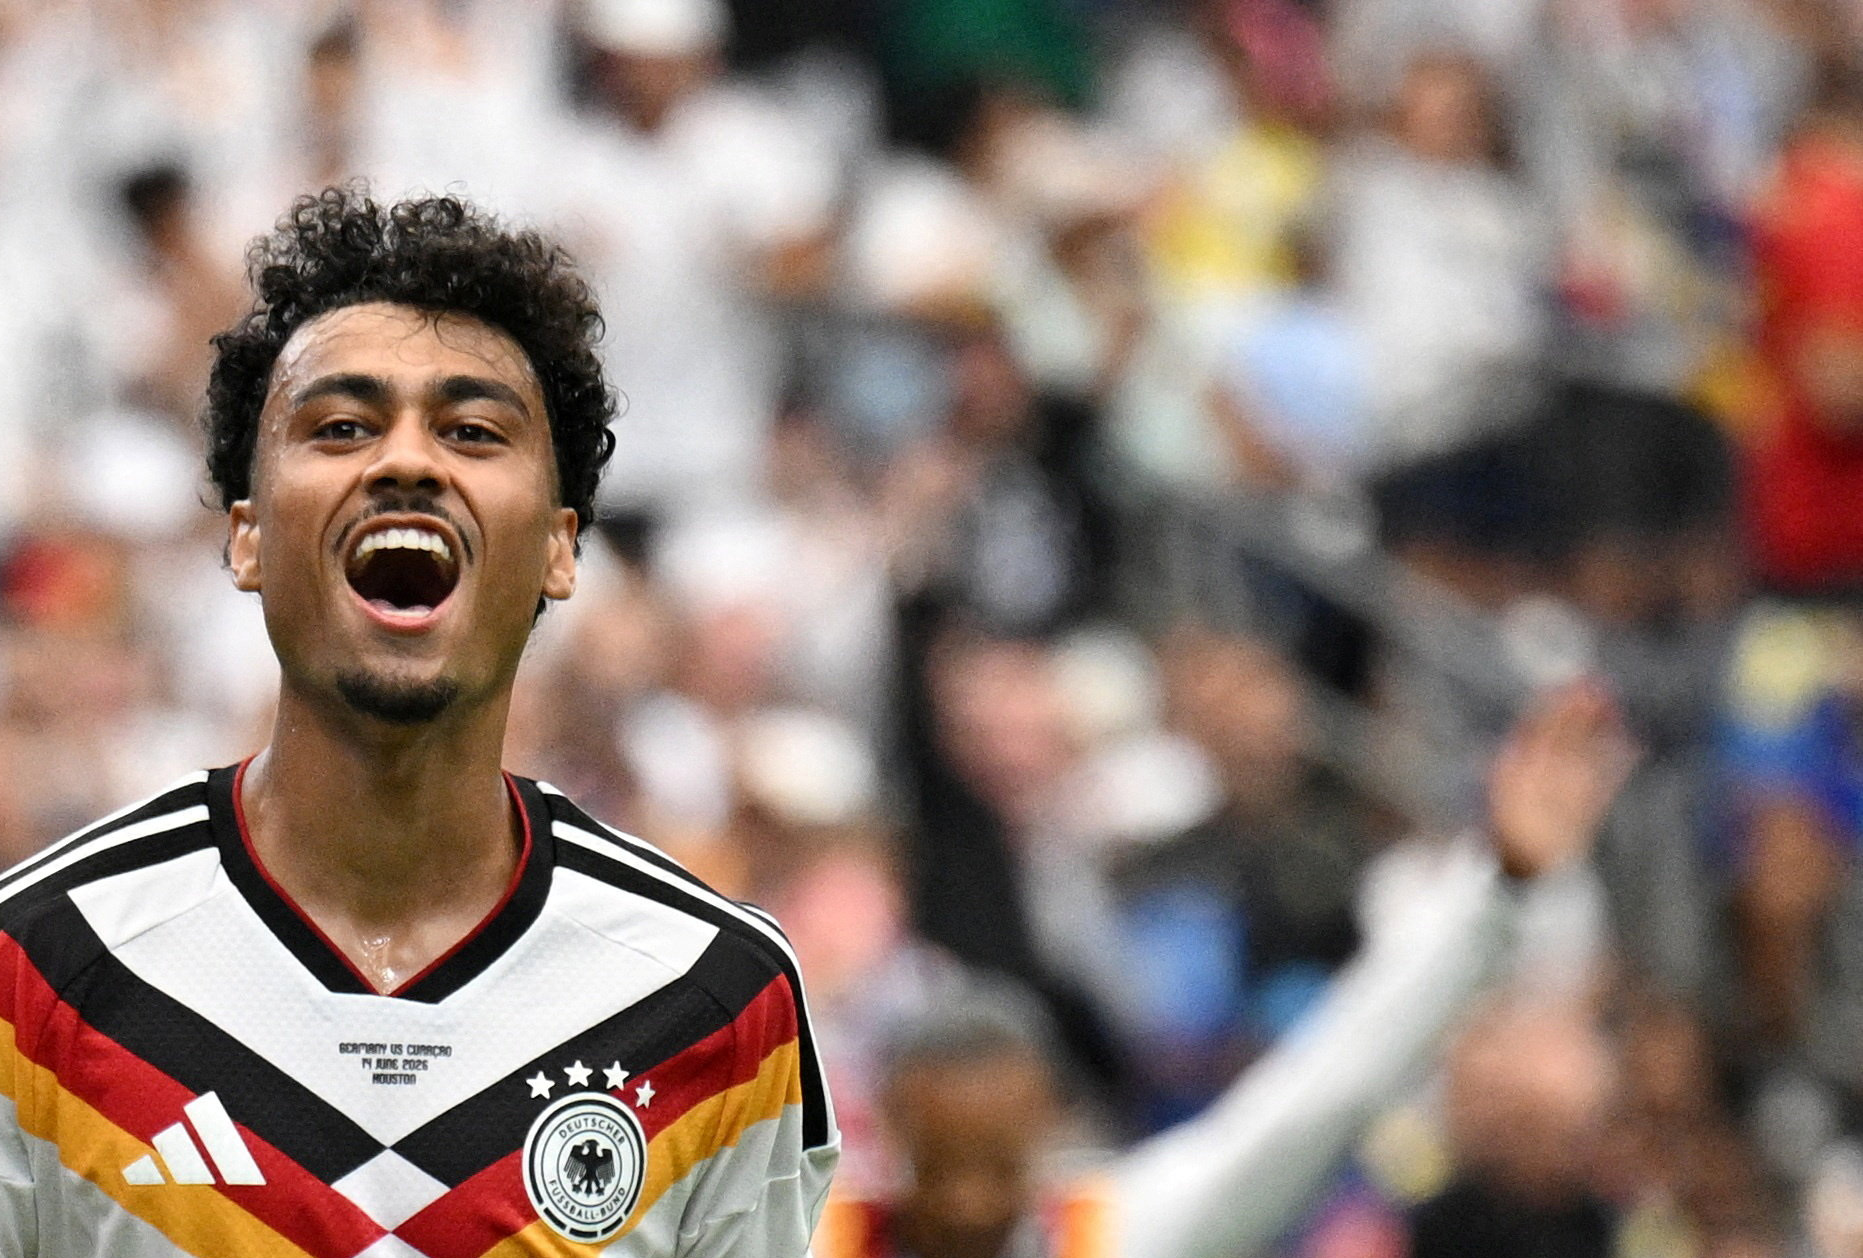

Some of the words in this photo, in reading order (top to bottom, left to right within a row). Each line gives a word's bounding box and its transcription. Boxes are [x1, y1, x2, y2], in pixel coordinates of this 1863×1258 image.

[339, 1042, 387, 1055] GERMANY
[361, 1058, 372, 1069] 14
[375, 1058, 399, 1070] JUNE
[402, 1059, 428, 1071] 2026
[372, 1073, 417, 1085] HOUSTON
[558, 1117, 625, 1146] DEUTSCHER
[548, 1179, 626, 1221] FUSSBALL-BUND
